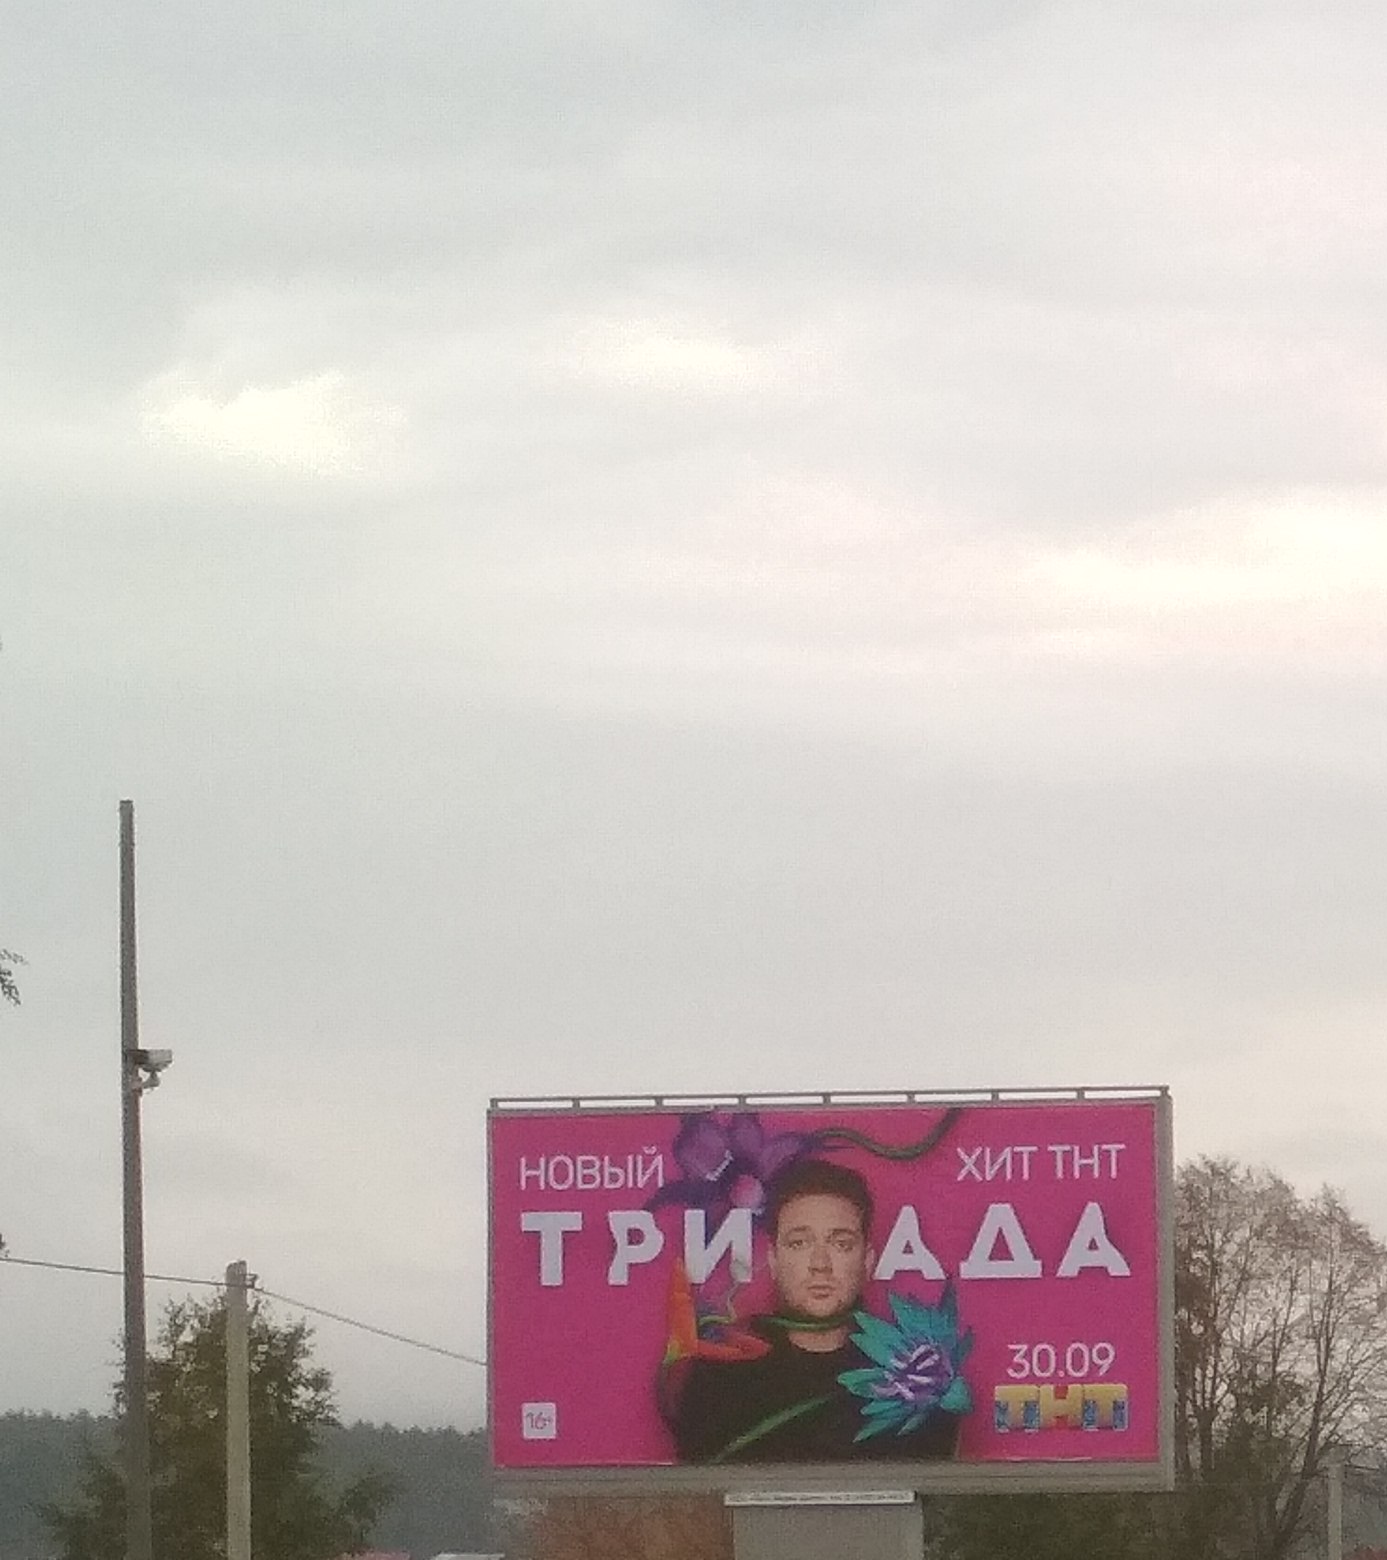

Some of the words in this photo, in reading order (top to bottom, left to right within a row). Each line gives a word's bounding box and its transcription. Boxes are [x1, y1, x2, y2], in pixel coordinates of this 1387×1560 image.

[519, 1145, 664, 1191] НОВЫЙ
[956, 1145, 1039, 1182] ХИТ
[1047, 1143, 1127, 1180] ТНТ
[1006, 1342, 1116, 1379] 30.09
